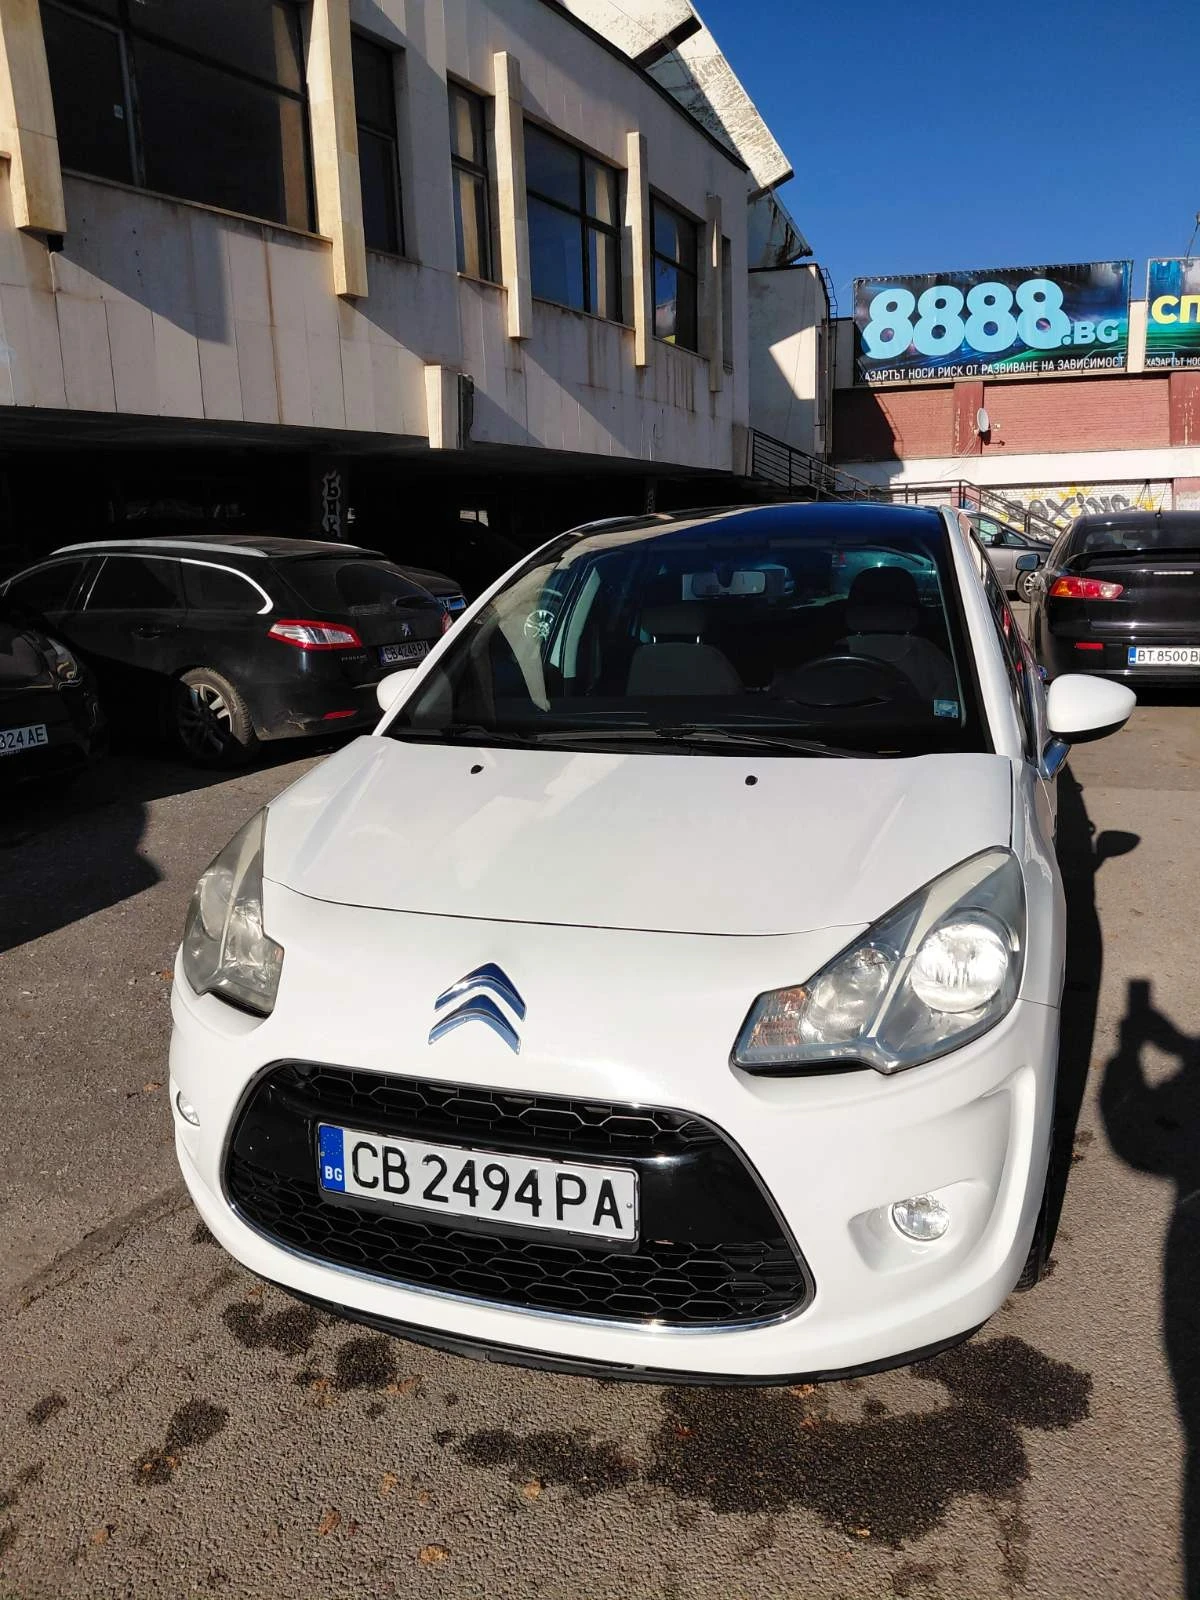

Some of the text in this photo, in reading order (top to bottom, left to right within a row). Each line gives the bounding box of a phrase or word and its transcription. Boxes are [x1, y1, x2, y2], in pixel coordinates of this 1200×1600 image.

[908, 365, 935, 379] НОСИ
[938, 363, 963, 377] РИСК
[966, 364, 978, 375] ОТ
[981, 361, 1038, 374] РАЗВИВАНЕ
[1042, 360, 1055, 370] НА
[325, 1165, 343, 1182] BG
[422, 1153, 543, 1218] 2494
